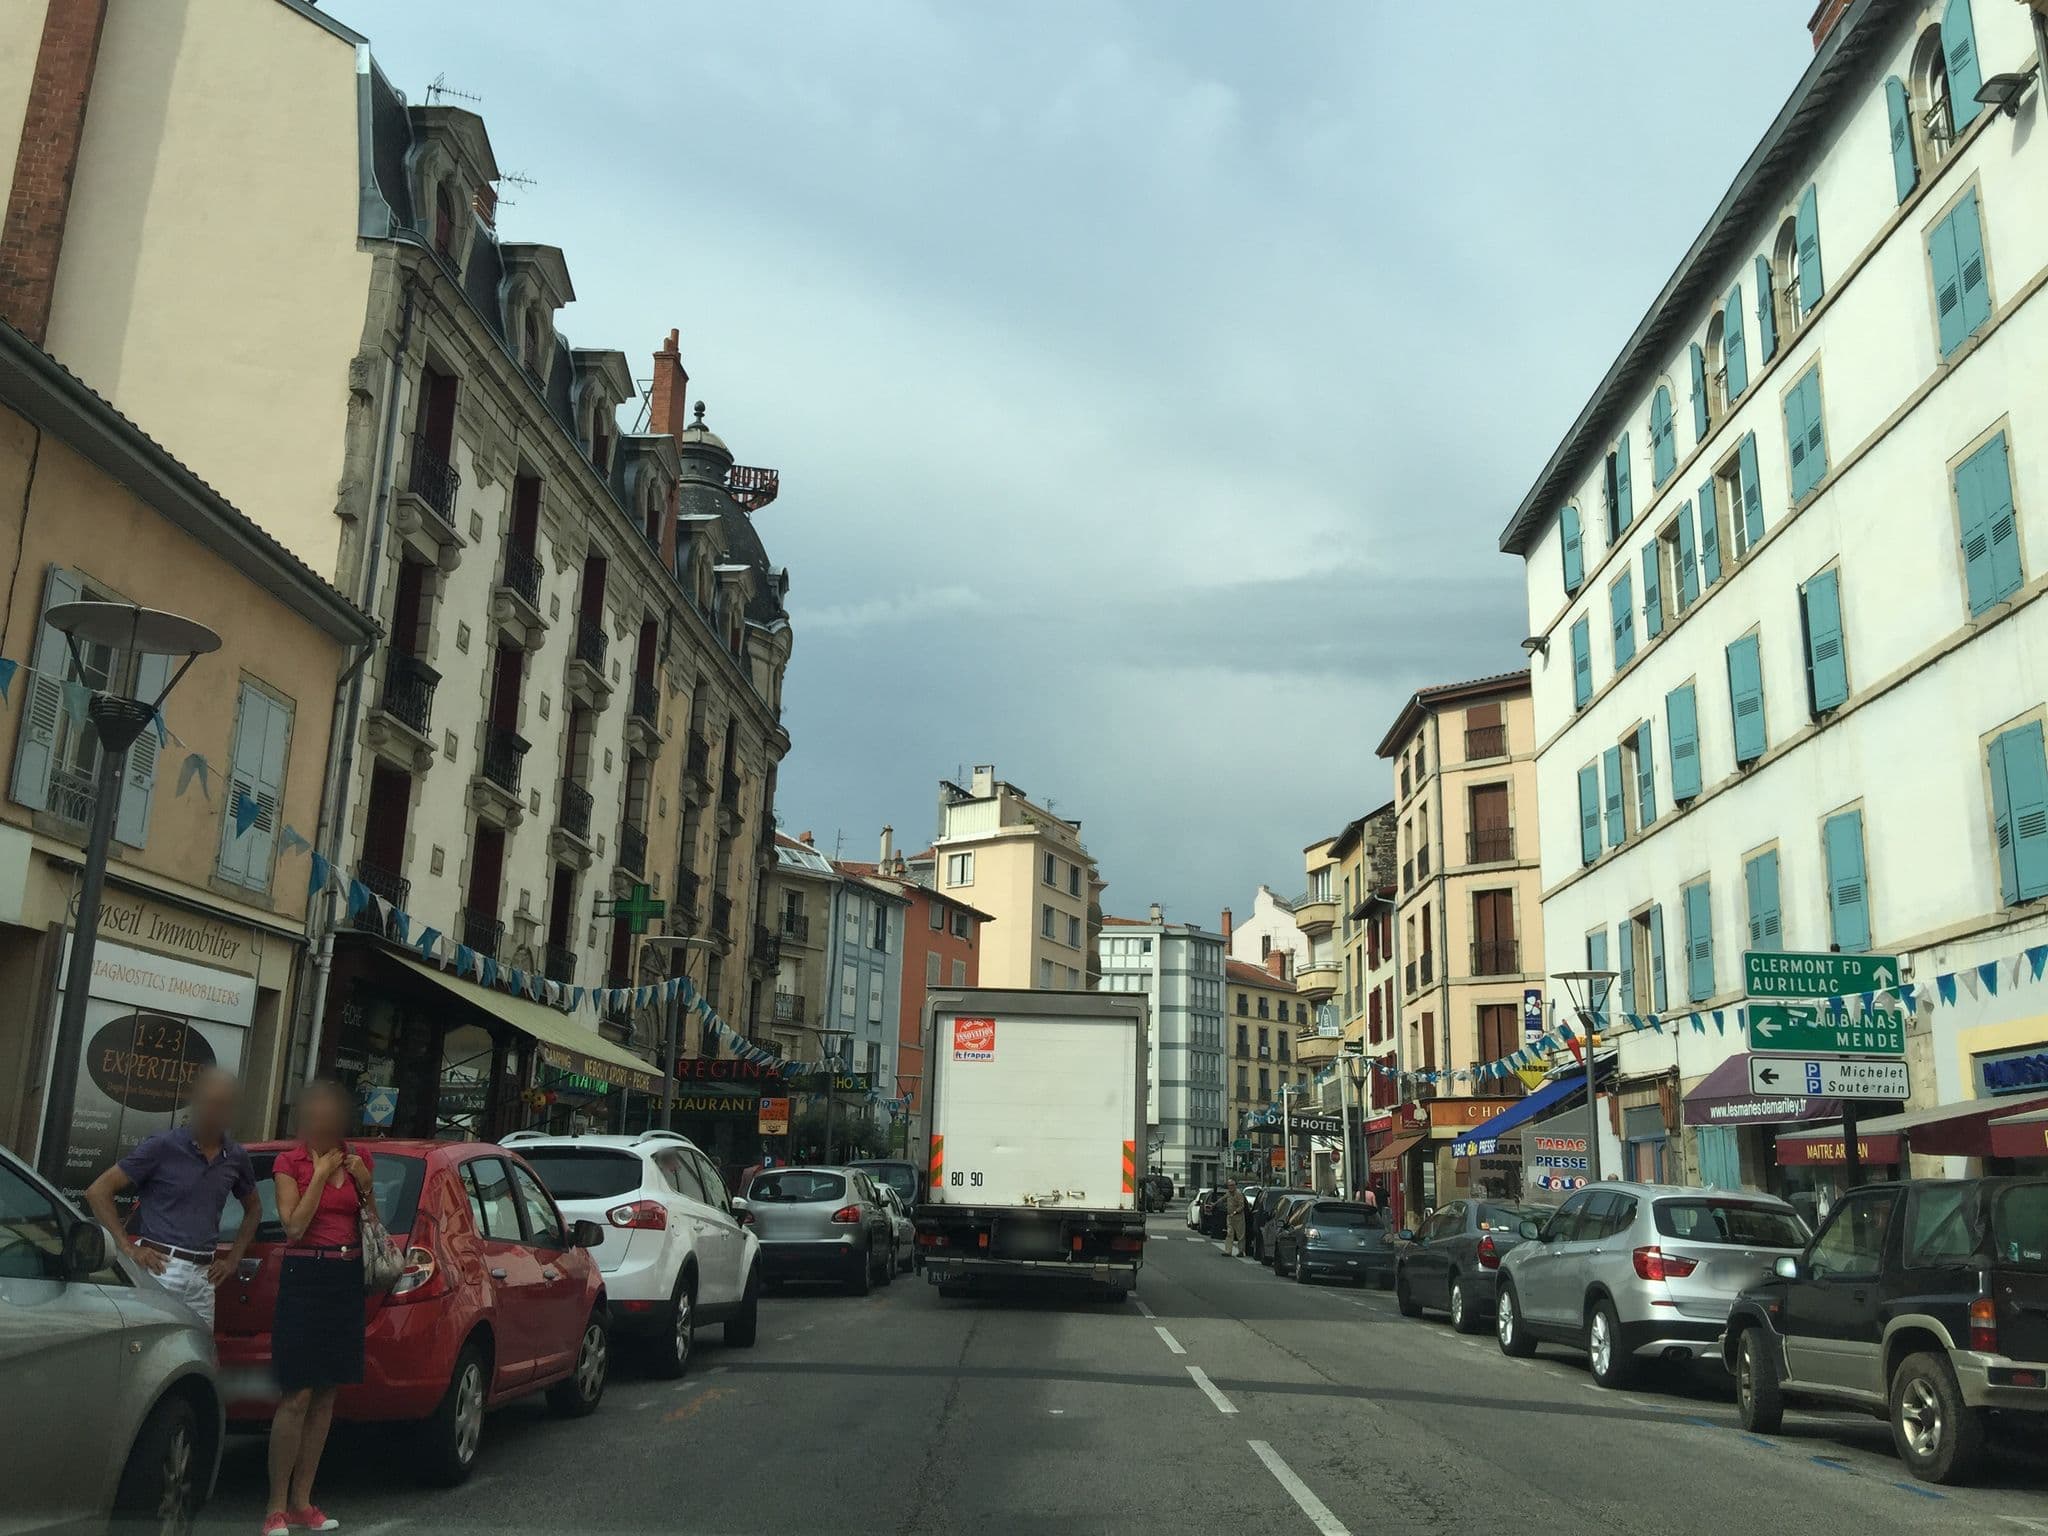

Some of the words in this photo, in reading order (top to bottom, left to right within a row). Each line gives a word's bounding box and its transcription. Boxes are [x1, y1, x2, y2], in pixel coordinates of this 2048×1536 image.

[147, 911, 241, 961] Immobilier
[1750, 958, 1834, 974] CLERMONT
[1842, 961, 1862, 975] FD
[168, 976, 241, 1007] IMMOBILIERS
[1752, 976, 1839, 993] AURILLAC
[1836, 1031, 1898, 1048] MENDE
[963, 1052, 991, 1060] frappa
[677, 1060, 781, 1079] REGINA
[1807, 1063, 1818, 1076] P
[1840, 1065, 1904, 1079] Michelet
[836, 1076, 868, 1090] HOEL
[1809, 1080, 1820, 1093] P
[1267, 1115, 1298, 1127] DYE
[1301, 1118, 1339, 1132] HOTEL
[1453, 1142, 1467, 1156] TABAC
[1478, 1138, 1496, 1154] PRESSE
[1536, 1137, 1587, 1152] TABAC
[763, 1156, 772, 1167] P
[1536, 1155, 1587, 1169] PRESSE
[951, 1172, 963, 1186] 80
[970, 1172, 983, 1187] 90
[1537, 1175, 1587, 1190] LOTO
